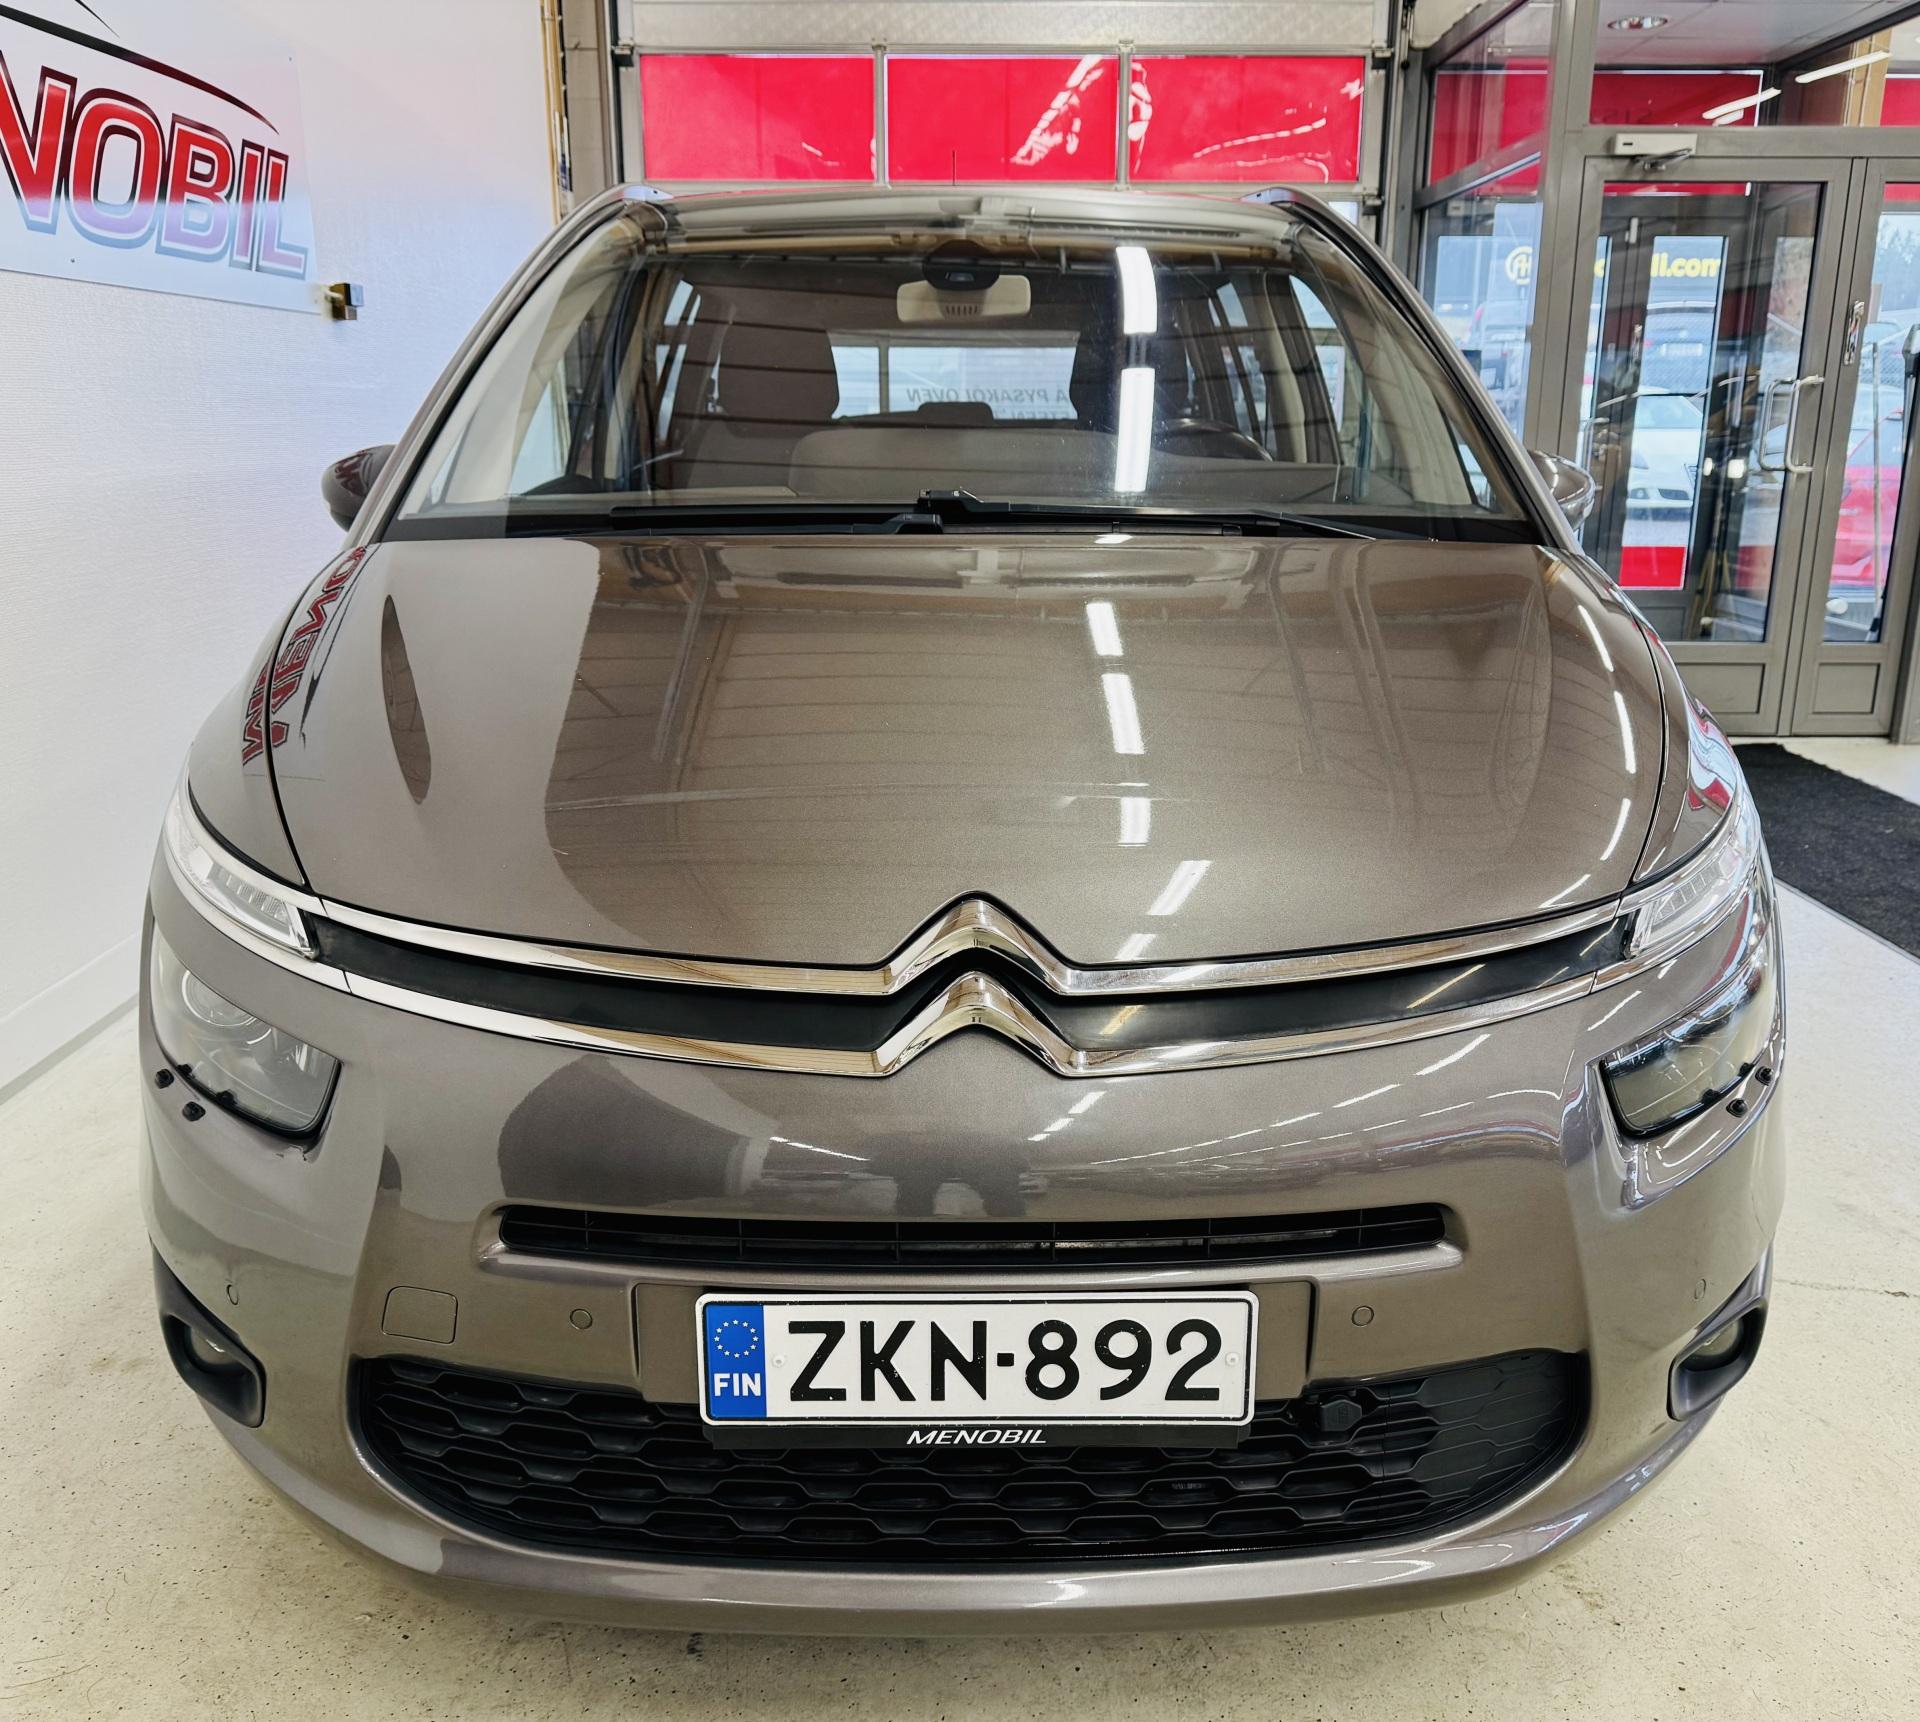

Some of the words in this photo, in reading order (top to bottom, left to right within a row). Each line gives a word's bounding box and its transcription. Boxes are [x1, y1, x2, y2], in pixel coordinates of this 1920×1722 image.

[788, 1318, 1223, 1401] ZKN-892
[713, 1373, 762, 1397] FIN
[907, 1429, 1047, 1445] MENOBIL
